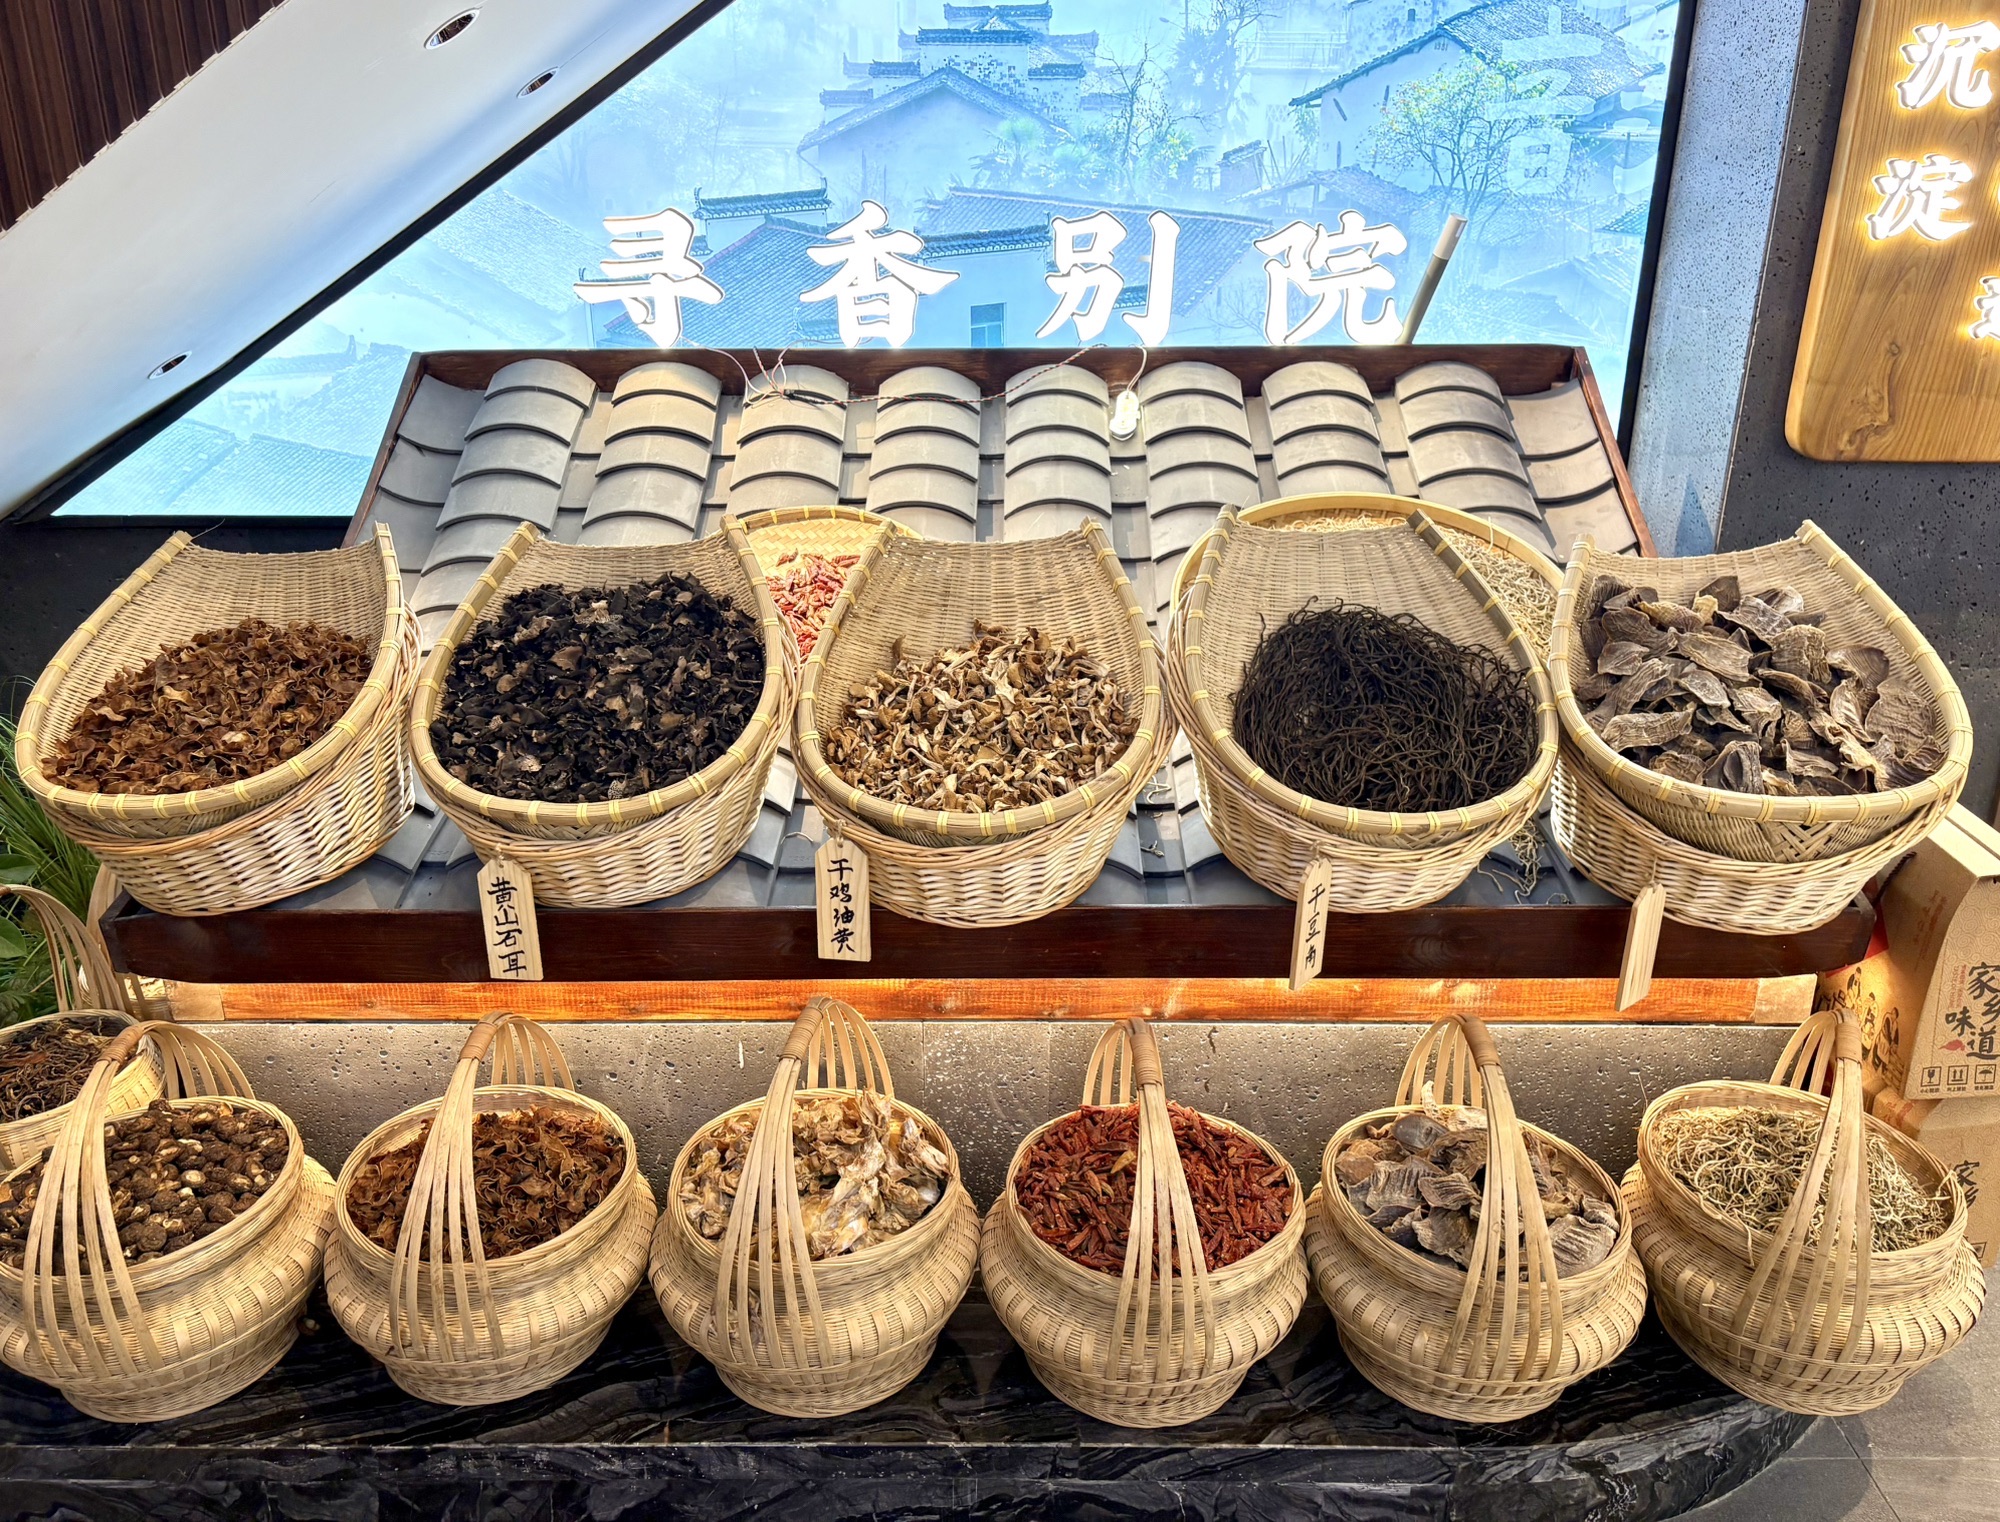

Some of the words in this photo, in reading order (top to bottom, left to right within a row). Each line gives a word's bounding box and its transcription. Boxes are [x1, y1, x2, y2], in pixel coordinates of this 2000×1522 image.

[1865, 20, 2000, 241] 沉淀
[573, 200, 1408, 349] 寻香别院
[487, 876, 527, 978] 黄山石耳
[827, 858, 856, 954] 干鸡油黄
